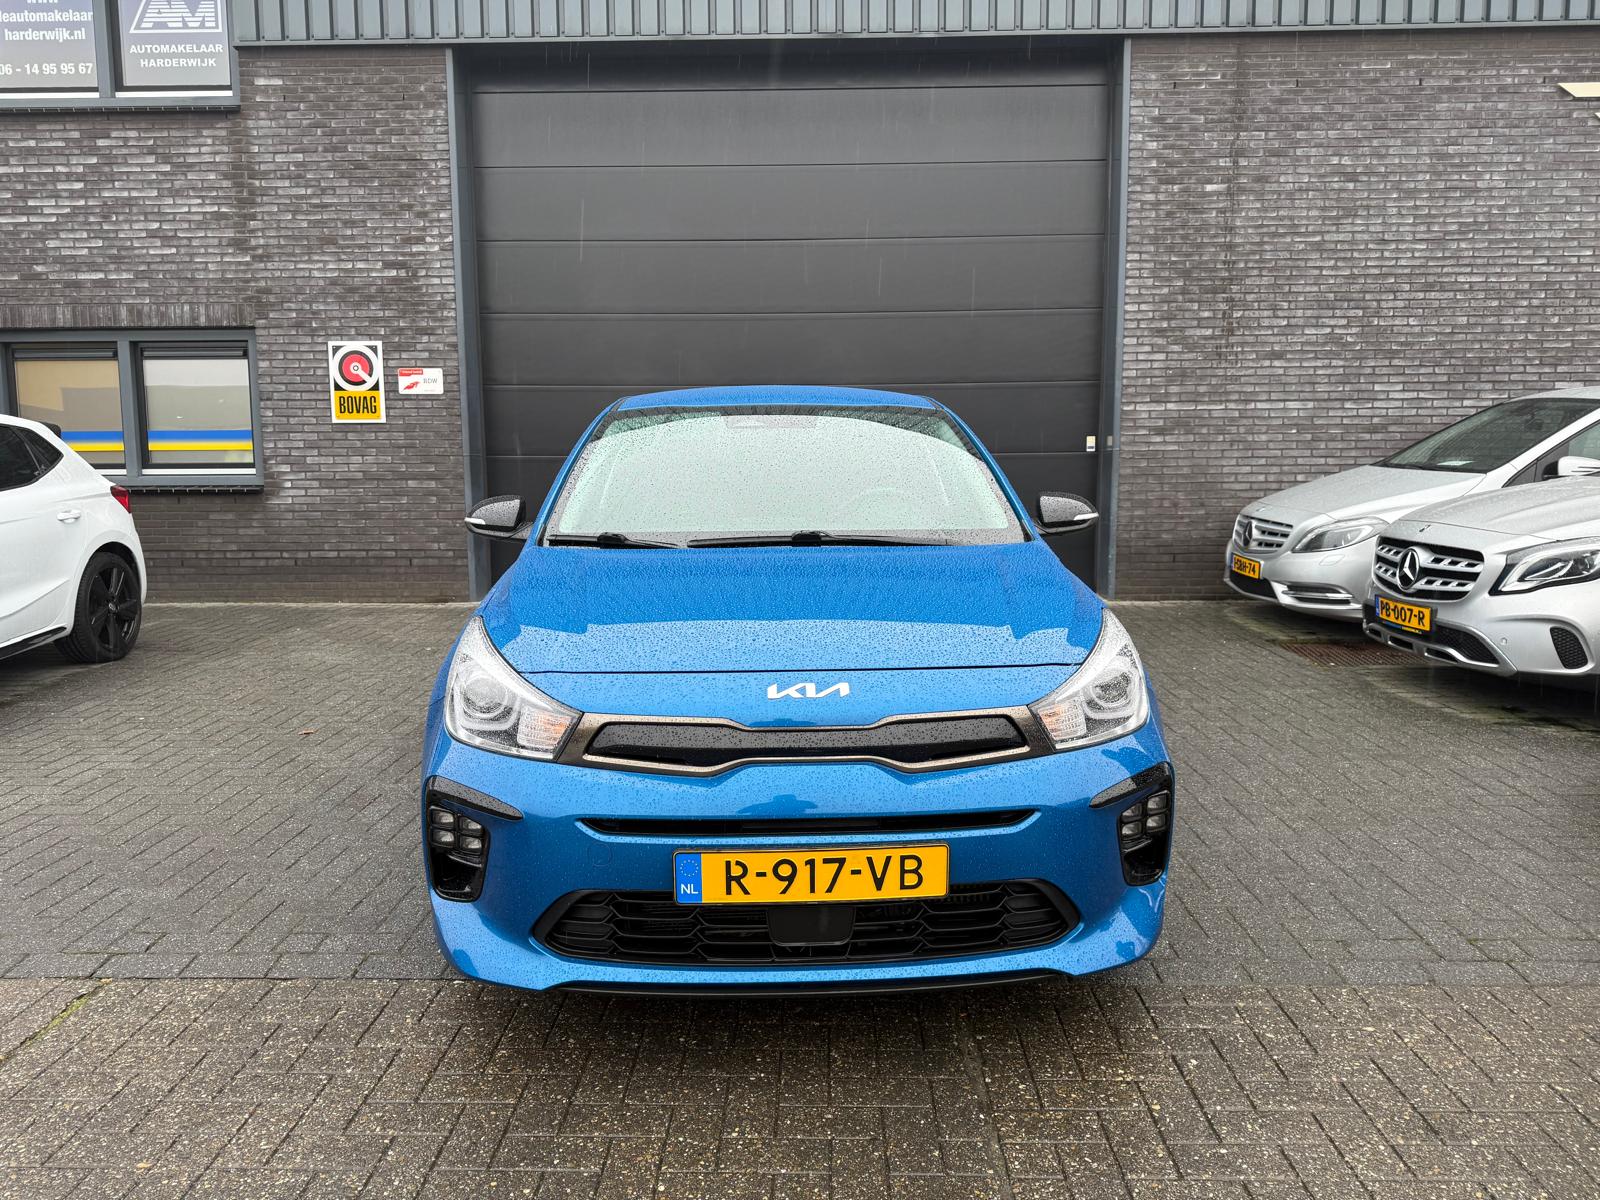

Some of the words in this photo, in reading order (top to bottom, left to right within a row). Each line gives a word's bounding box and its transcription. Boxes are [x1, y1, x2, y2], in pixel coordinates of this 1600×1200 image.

[4, 28, 86, 43] harderwijk.nl
[129, 44, 223, 54] AUTOMAKELAAR
[24, 63, 39, 75] 14
[42, 63, 57, 75] 95
[60, 63, 75, 75] 95
[78, 63, 93, 75] 67
[140, 58, 216, 68] HARDERWIJK
[338, 395, 377, 414] BOVAG
[1380, 599, 1425, 627] PB-007-R
[767, 682, 850, 699] KIA
[680, 883, 699, 895] NL
[725, 854, 924, 896] R-917-VB
